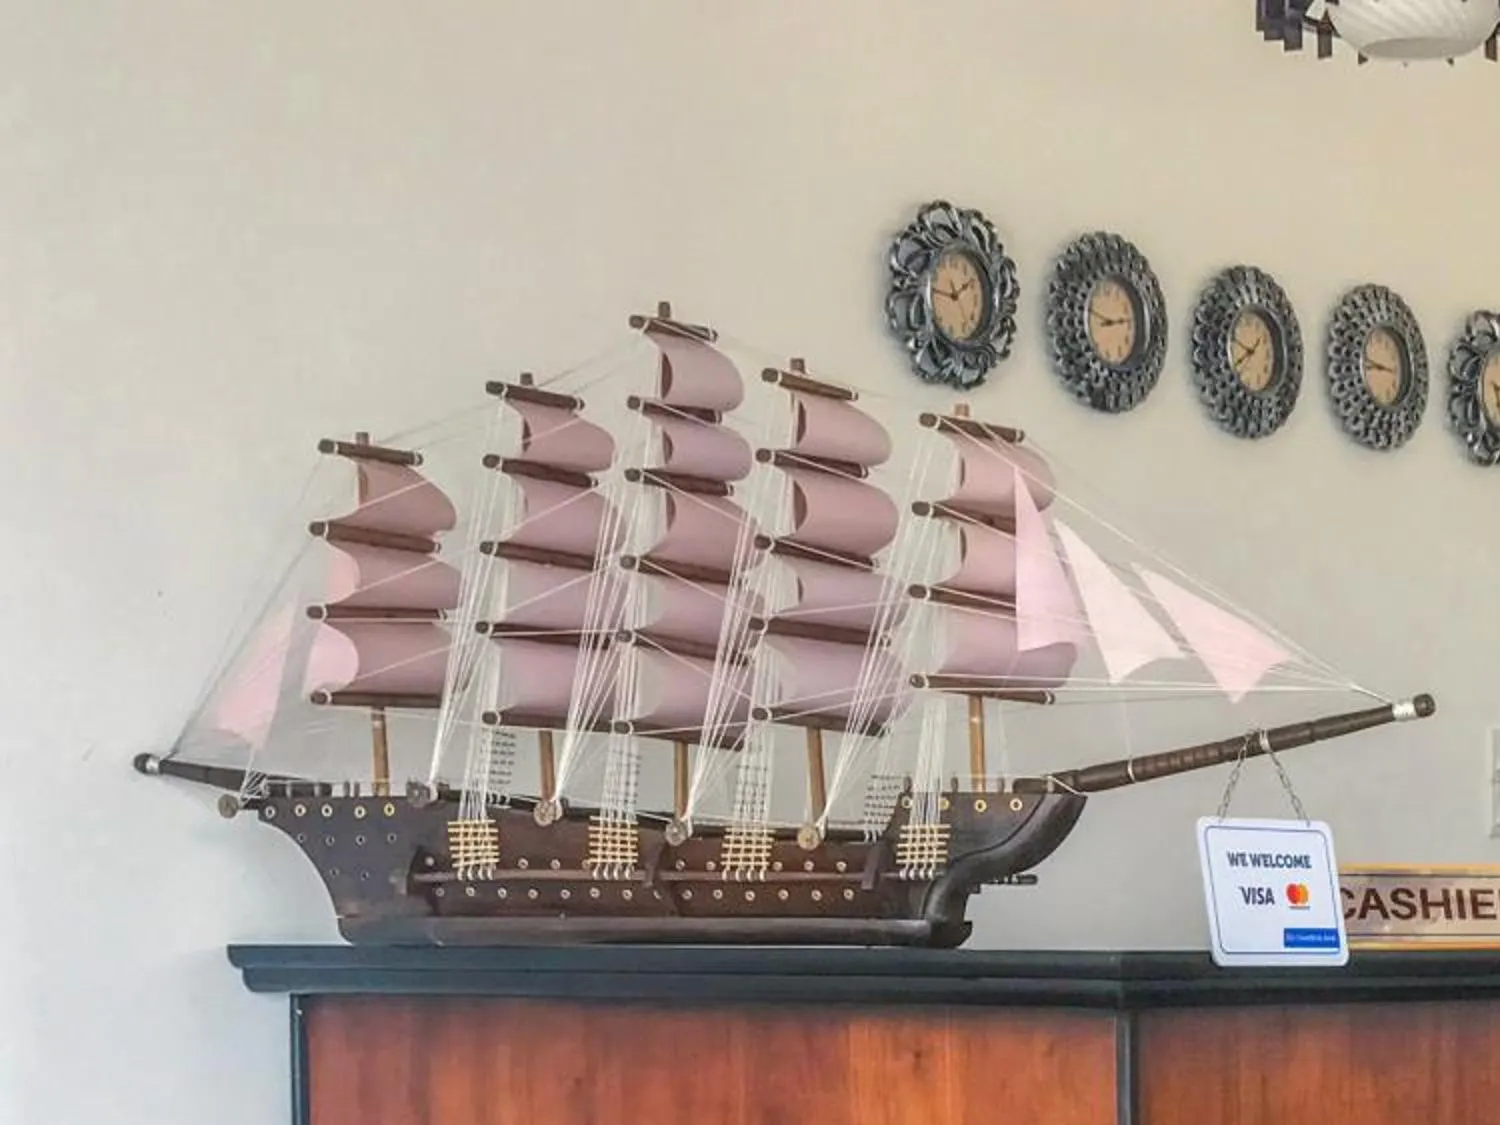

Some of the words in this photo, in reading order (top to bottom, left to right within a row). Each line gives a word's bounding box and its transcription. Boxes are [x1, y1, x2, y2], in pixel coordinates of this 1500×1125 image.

[1227, 852, 1248, 867] WE
[1249, 853, 1312, 869] WELCOME
[1239, 886, 1275, 905] VISA
